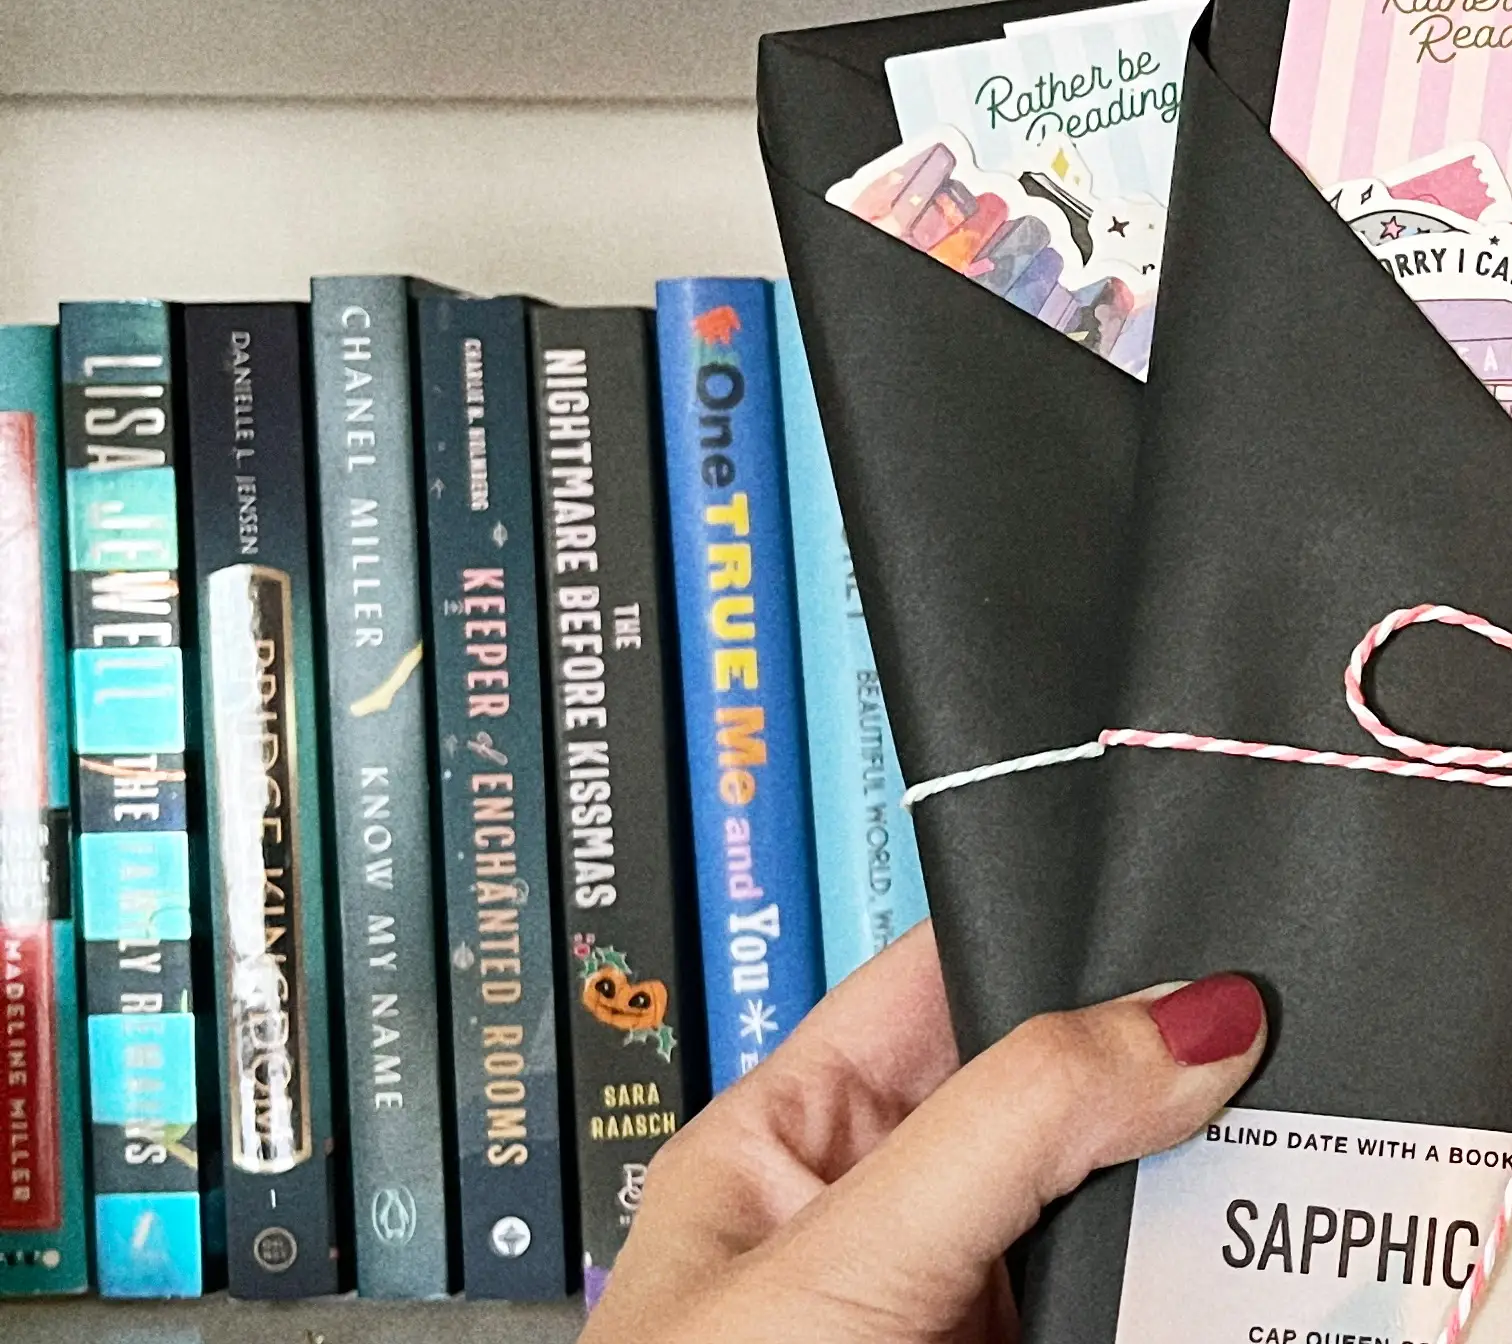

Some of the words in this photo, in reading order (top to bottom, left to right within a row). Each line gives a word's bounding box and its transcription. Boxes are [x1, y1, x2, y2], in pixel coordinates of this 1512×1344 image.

[974, 63, 1113, 131] Rather
[1117, 48, 1162, 82] be
[84, 353, 167, 471] LISA
[340, 305, 379, 474] CHANEL
[697, 362, 746, 490] One
[545, 349, 599, 575] NIGHTMARE
[348, 498, 383, 650] MILLER
[613, 602, 643, 652] THE
[703, 493, 759, 694] TRUE
[462, 567, 511, 719] KEEPER
[557, 586, 609, 732] BEFORE
[357, 765, 396, 891] KNOW
[567, 741, 618, 909] KISSMAS
[721, 817, 765, 902] and
[366, 913, 399, 973] MY
[471, 773, 523, 1005] ENCHANTED
[727, 903, 781, 995] You
[370, 992, 404, 1111] NAME
[481, 1025, 529, 1168] ROOMS
[603, 1082, 661, 1108] SARA
[590, 1111, 678, 1140] RAASCH
[1206, 1123, 1279, 1149] BLIND
[1287, 1130, 1350, 1156] DATE
[1356, 1136, 1418, 1161] WITH
[1222, 1198, 1482, 1292] SAPPHIC
